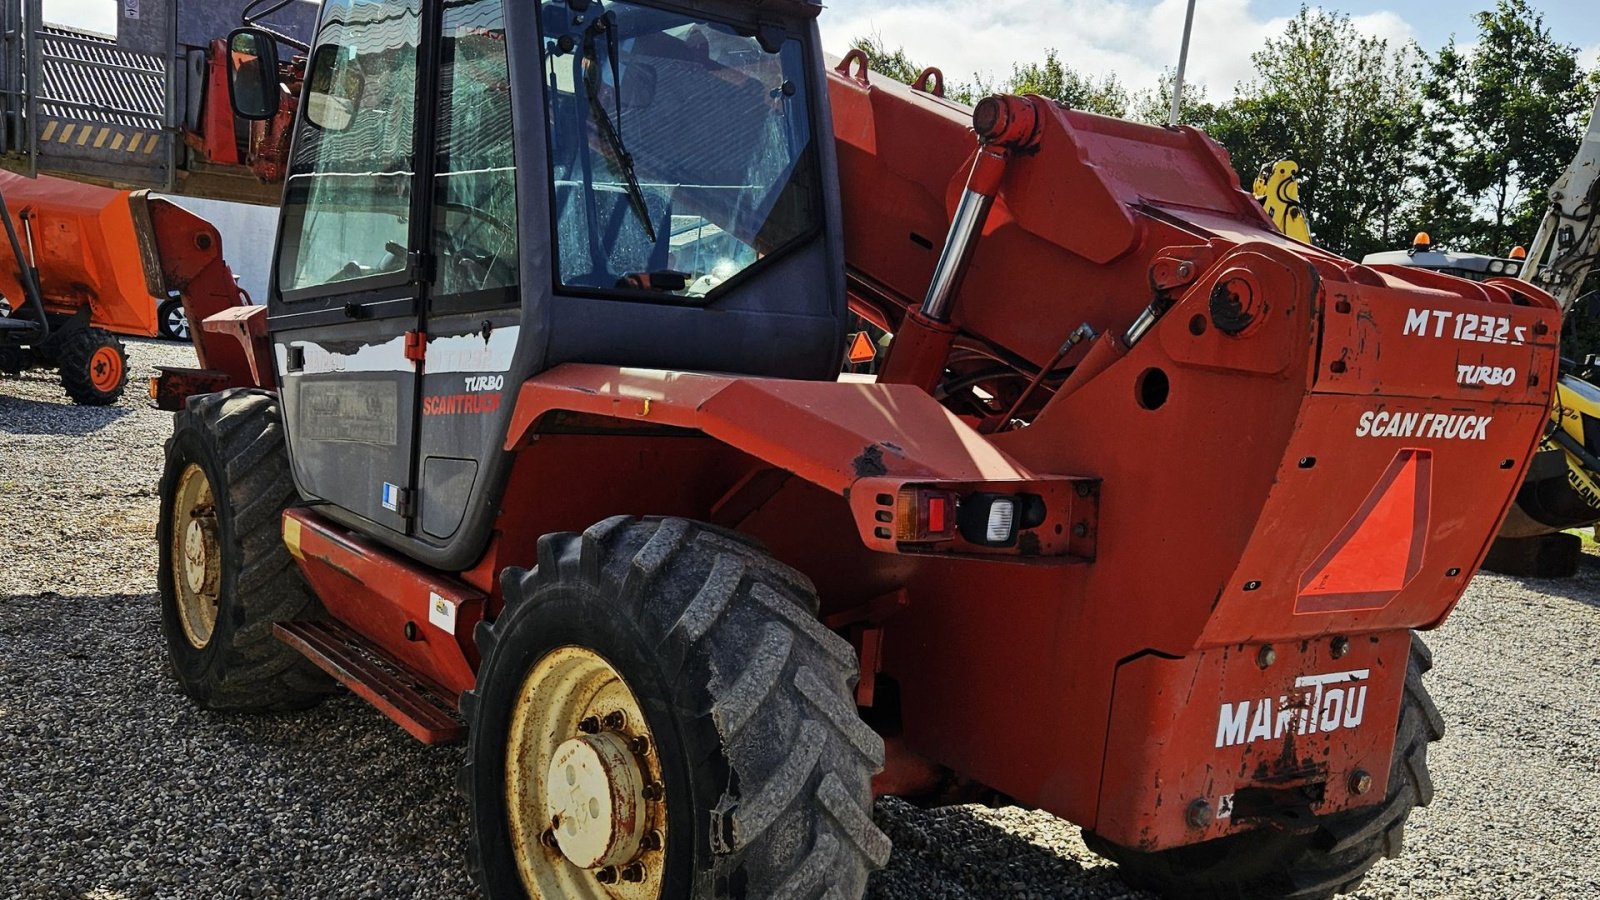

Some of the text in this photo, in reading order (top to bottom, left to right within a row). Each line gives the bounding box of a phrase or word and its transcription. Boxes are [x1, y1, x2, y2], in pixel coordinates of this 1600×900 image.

[464, 374, 504, 392] TURBO
[1456, 364, 1516, 386] TURBO
[1355, 410, 1492, 441] SCANTRUCK
